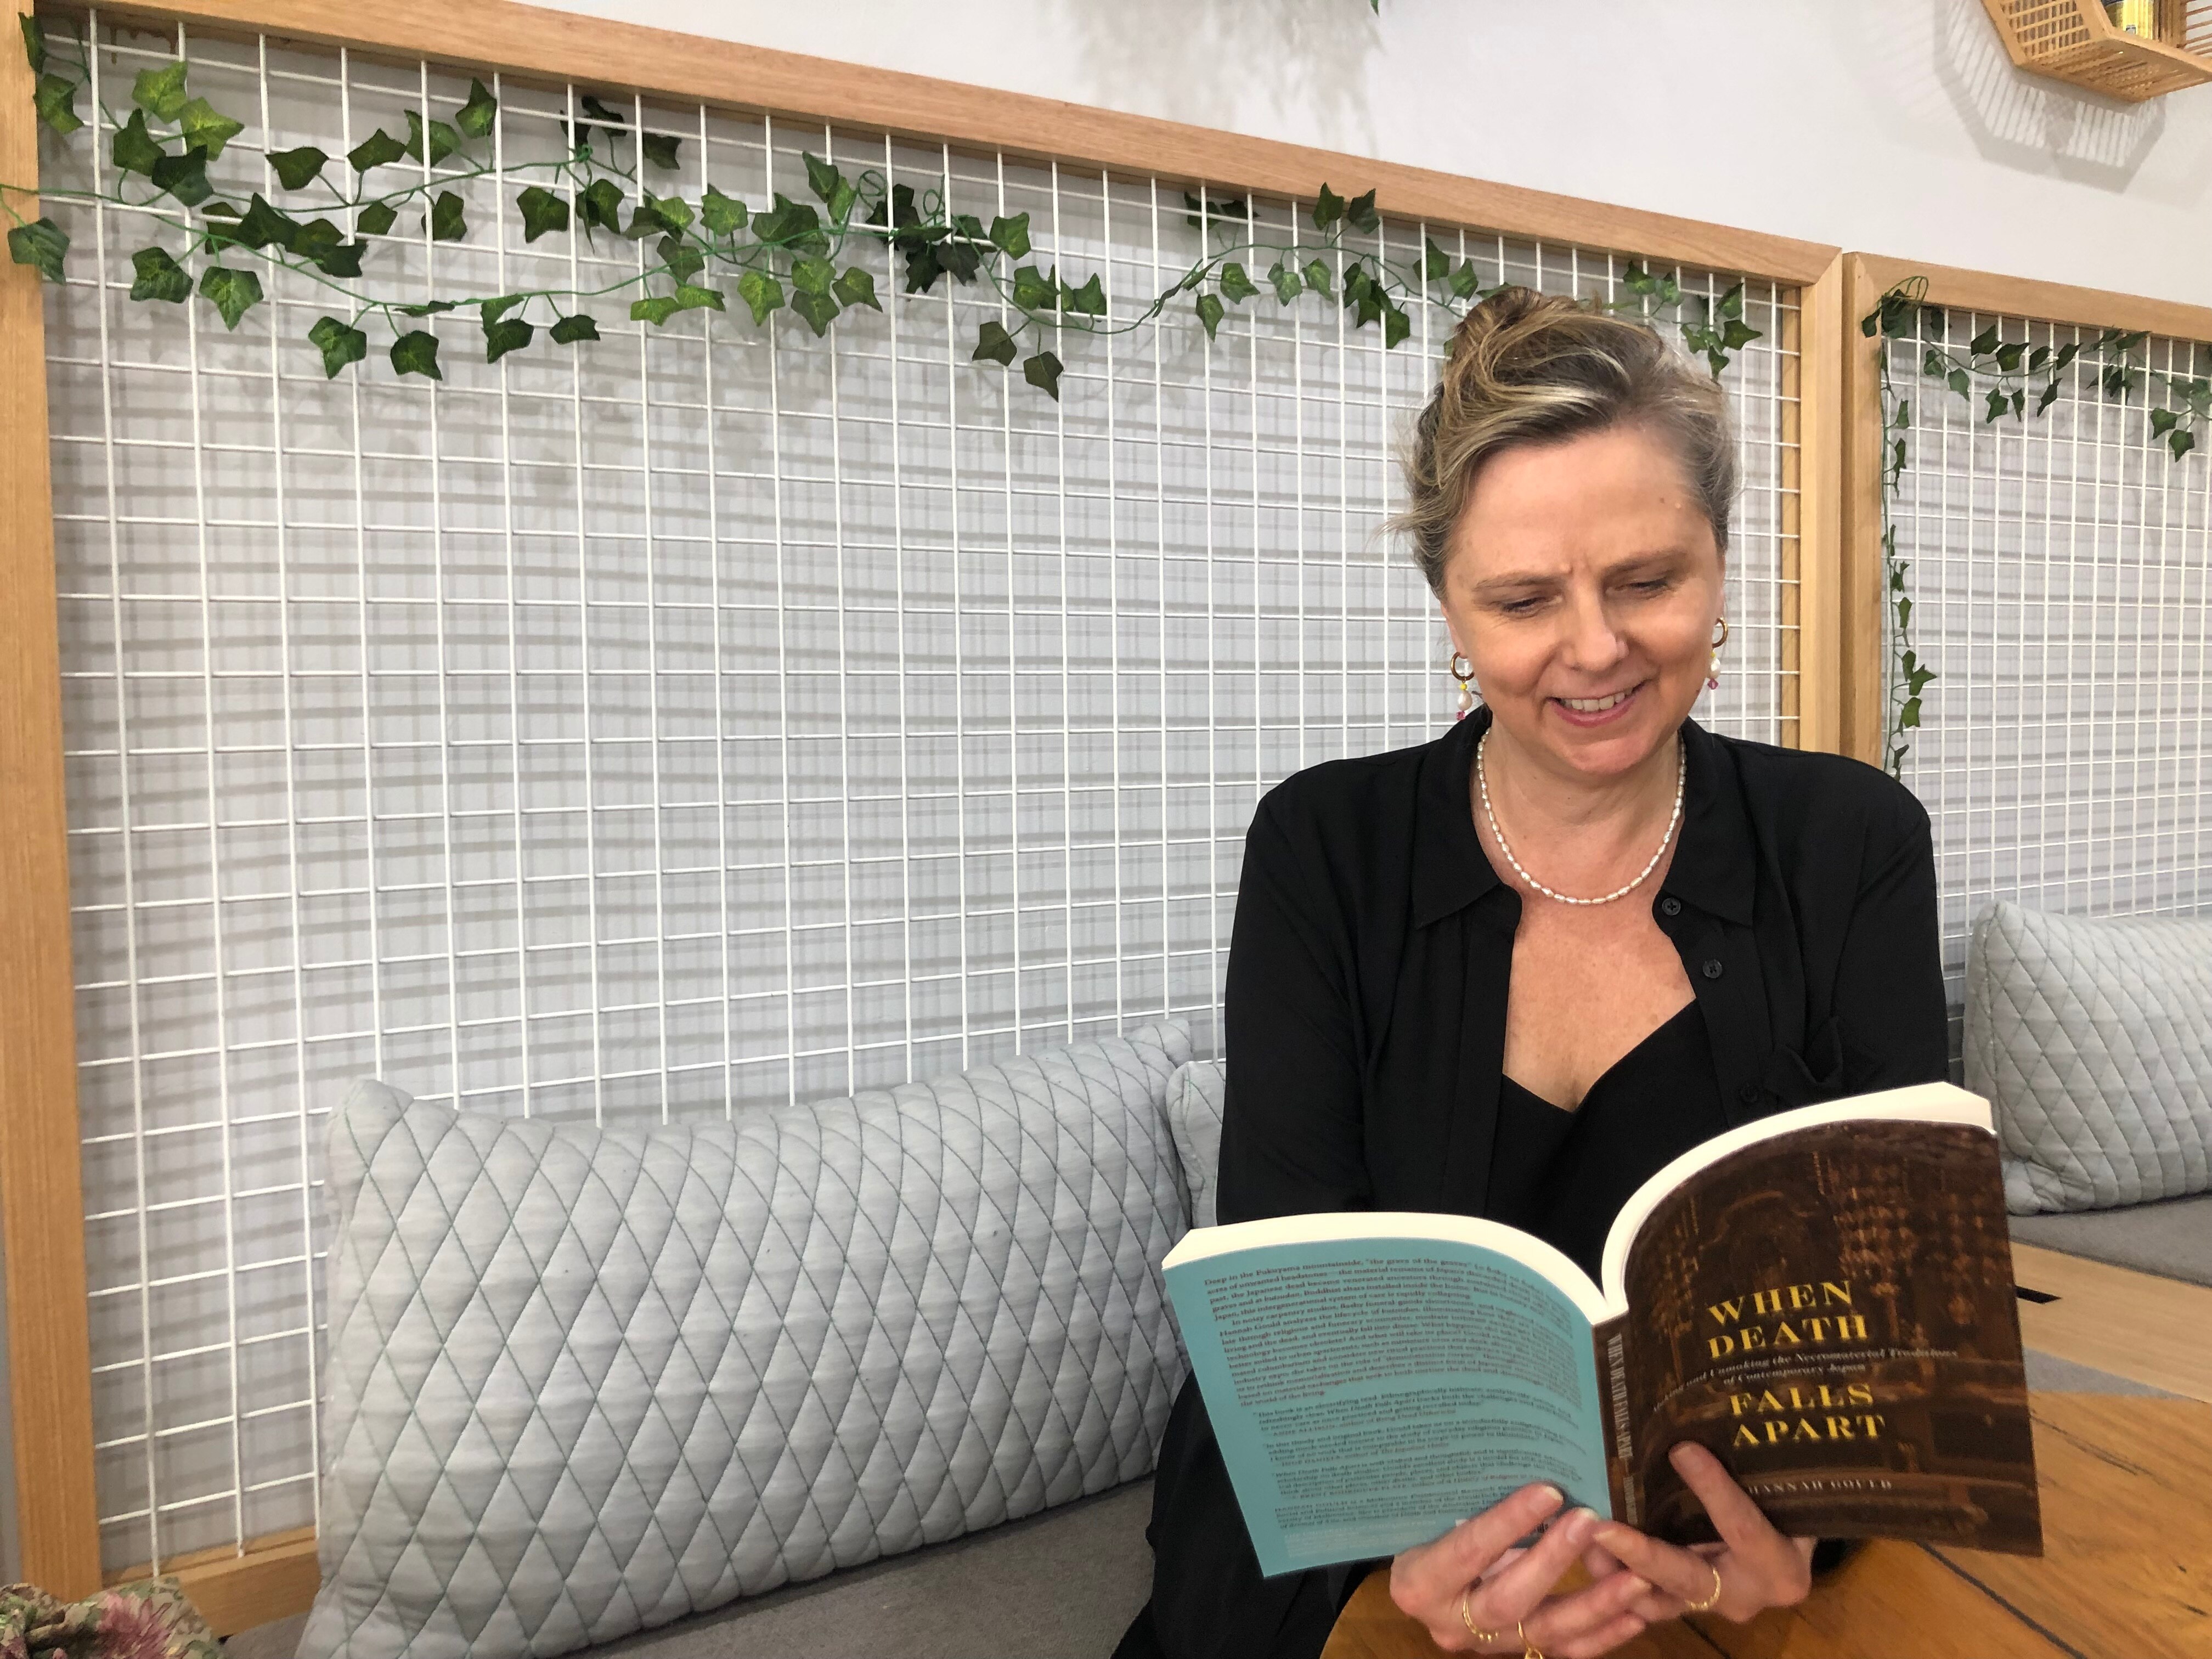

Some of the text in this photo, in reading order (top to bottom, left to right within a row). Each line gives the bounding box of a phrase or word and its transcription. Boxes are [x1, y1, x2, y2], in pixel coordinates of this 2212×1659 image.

[1708, 1280, 1852, 1325] WHEN
[1606, 1333, 1626, 1368] WHEN
[1707, 1314, 1867, 1359] DEATH
[1723, 1375, 1735, 1386] of
[1828, 1363, 1866, 1374] Japan
[1772, 1353, 1792, 1365] the
[1610, 1368, 1627, 1401] DEATH
[1730, 1383, 1874, 1416] FALLS
[1614, 1401, 1630, 1430] FALLS
[1734, 1414, 1886, 1447] APART
[1616, 1430, 1633, 1459] APART
